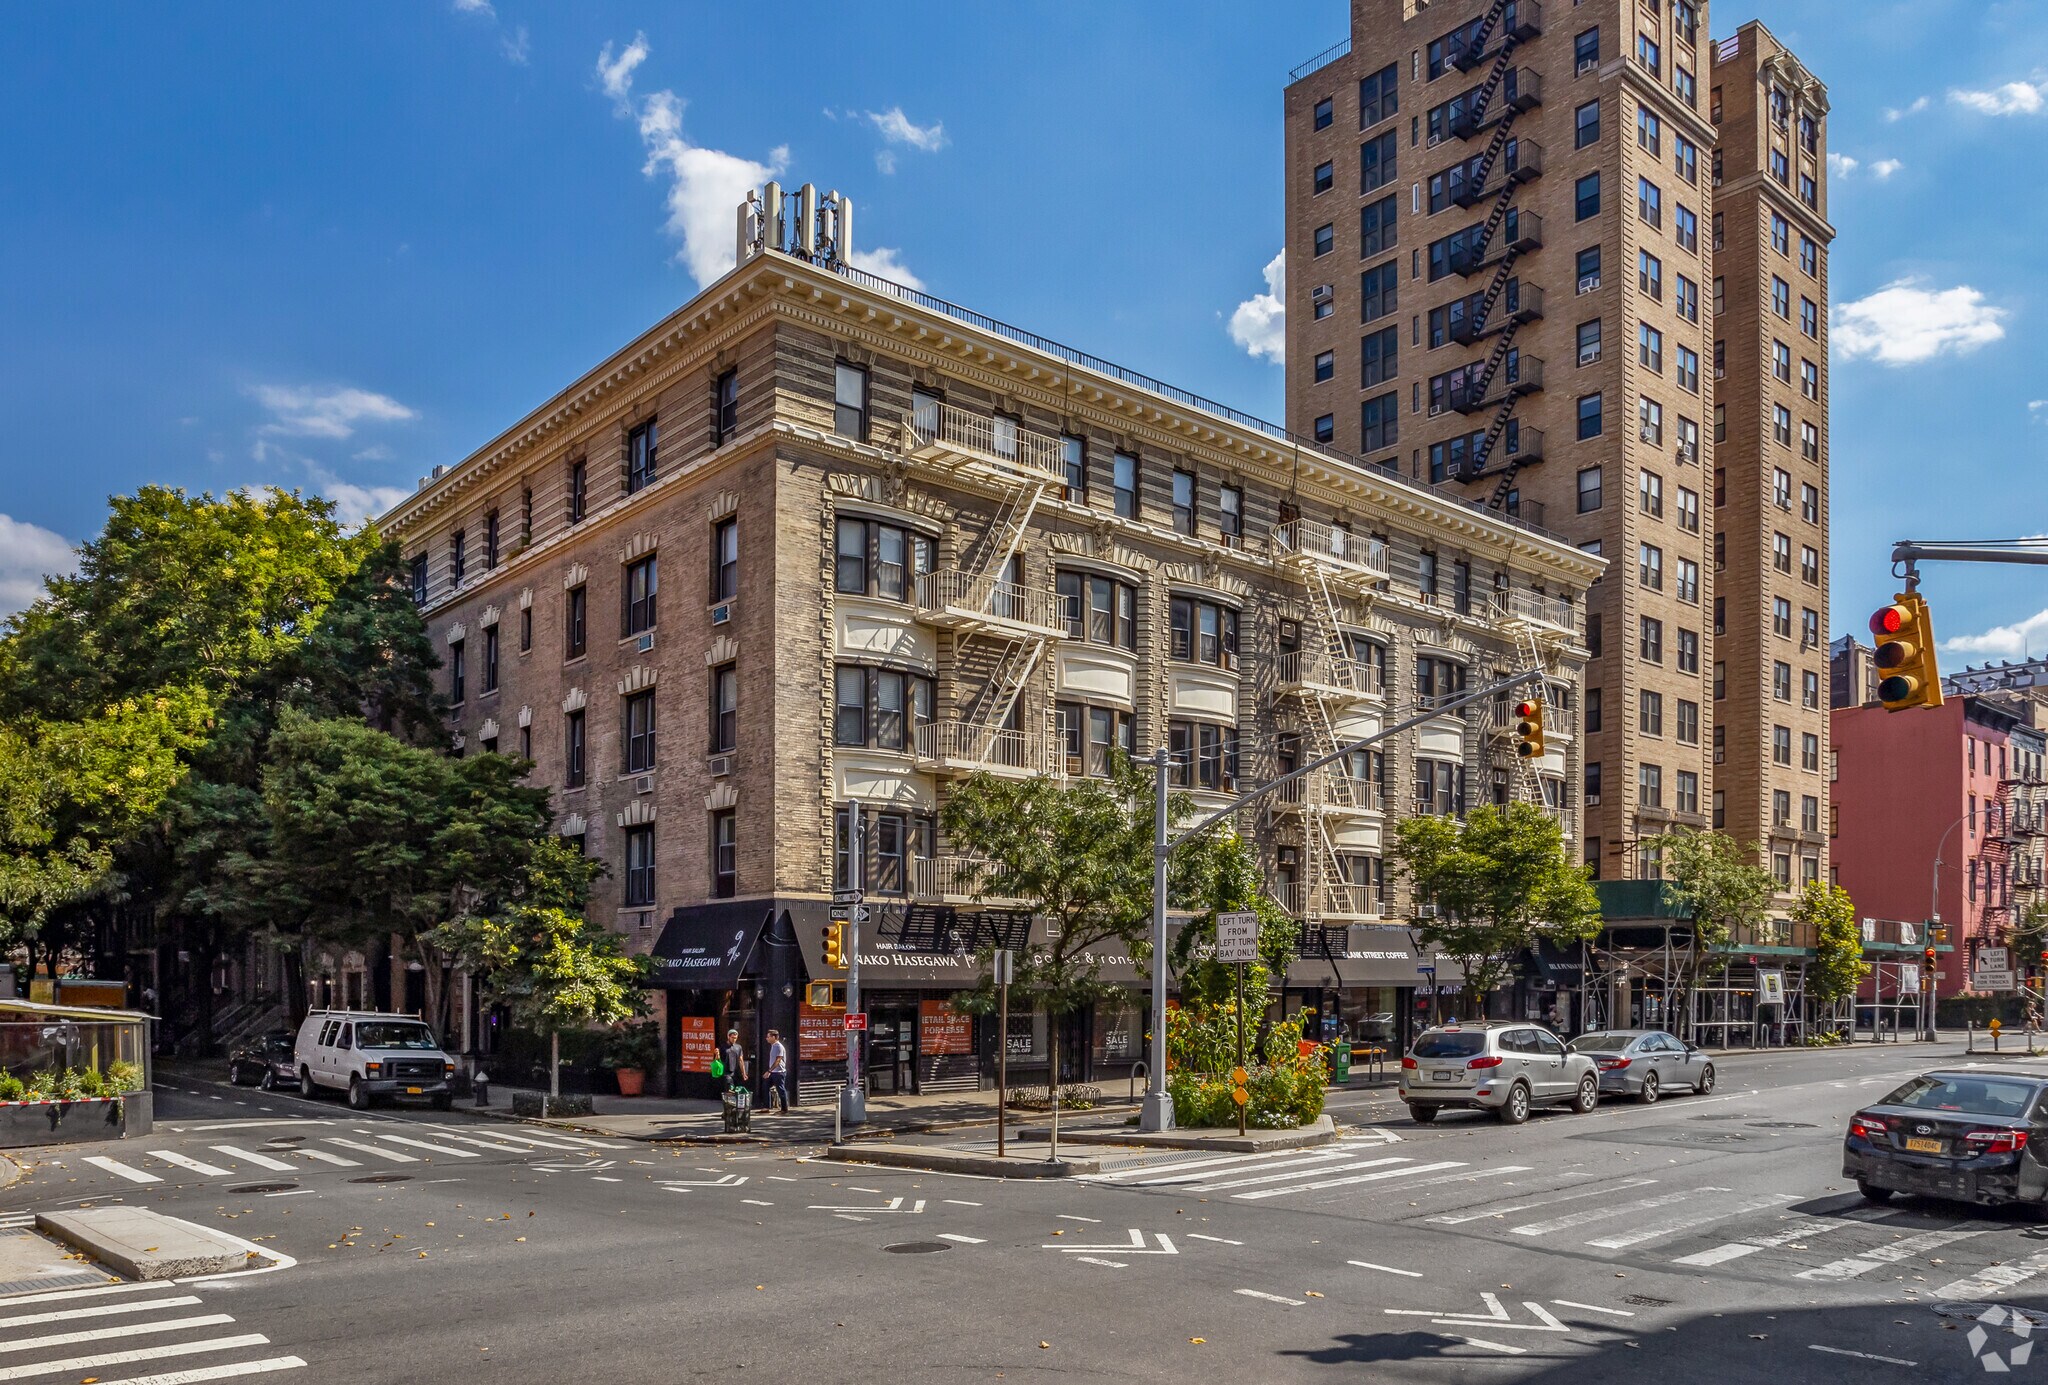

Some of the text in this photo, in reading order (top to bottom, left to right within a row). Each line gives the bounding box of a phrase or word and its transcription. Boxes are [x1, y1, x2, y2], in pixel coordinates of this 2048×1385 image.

[1219, 916, 1255, 926] LEFT TURN
[1227, 927, 1248, 936] FROM
[894, 943, 917, 951] SALON
[1219, 937, 1256, 947] LEFT TURN
[1084, 951, 1095, 964] &
[1220, 949, 1235, 958] BAY
[1237, 948, 1255, 957] ONLY
[1363, 951, 1385, 959] STREET
[1385, 951, 1409, 959] COFFEE
[682, 957, 721, 967] HASEGAWA
[840, 952, 959, 967] MNAKO HASEGAWA
[800, 1018, 830, 1027] RETAIL
[682, 1032, 714, 1040] RETAIL SPACE
[806, 1030, 847, 1038] FOR LEAS
[1006, 1038, 1032, 1048] SALE
[1105, 1035, 1128, 1045] SALE
[685, 1043, 711, 1051] FOR LEASE
